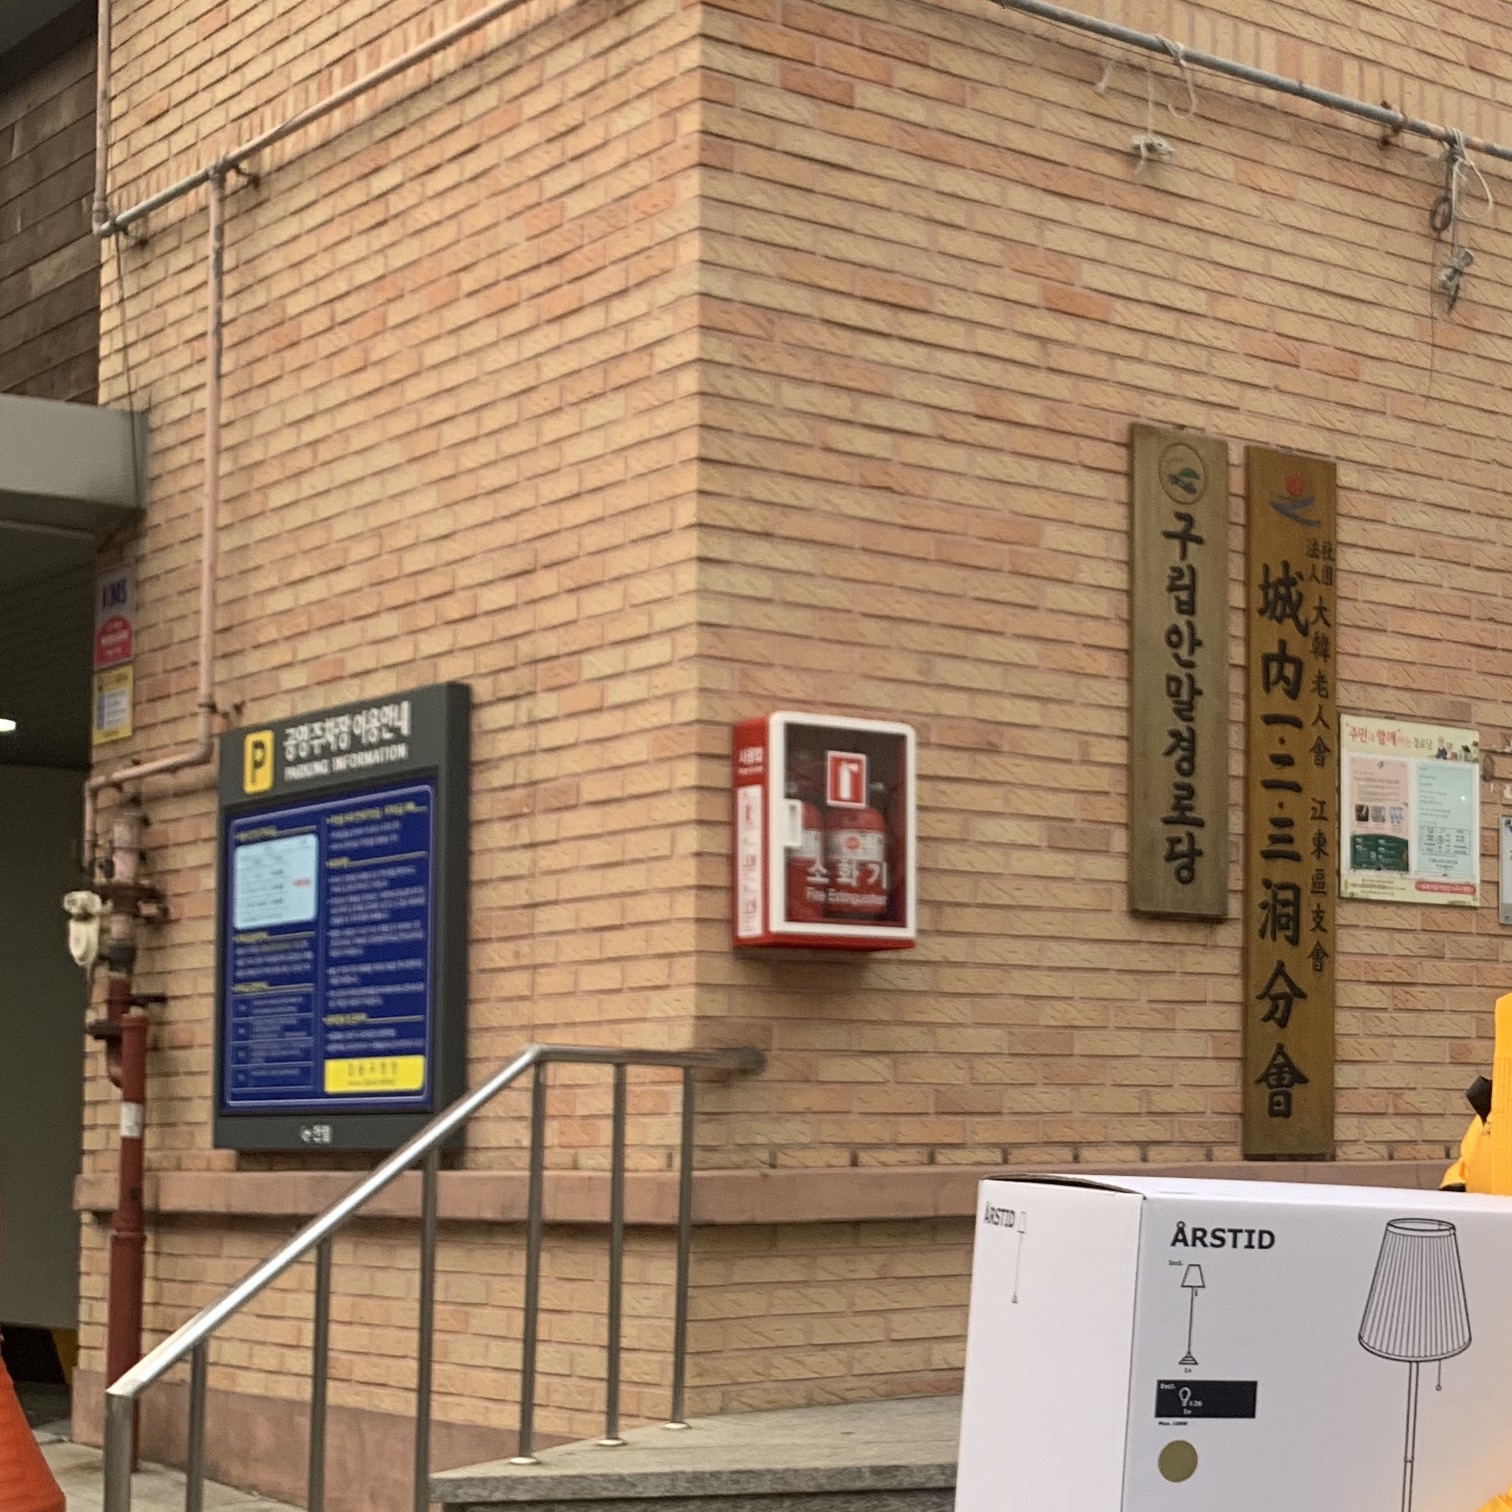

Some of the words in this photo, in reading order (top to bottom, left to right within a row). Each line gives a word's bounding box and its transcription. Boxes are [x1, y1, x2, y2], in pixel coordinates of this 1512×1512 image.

[1162, 511, 1205, 886] 구립안말경로당
[283, 713, 351, 762] 공영주차장
[353, 700, 411, 746] 이용안내
[284, 758, 331, 782] PARKING
[332, 743, 409, 773] INFORMATION
[806, 854, 887, 889] 소화기
[983, 1201, 1016, 1228] ÅRSTID
[1169, 1220, 1276, 1250] ÅRSTID
